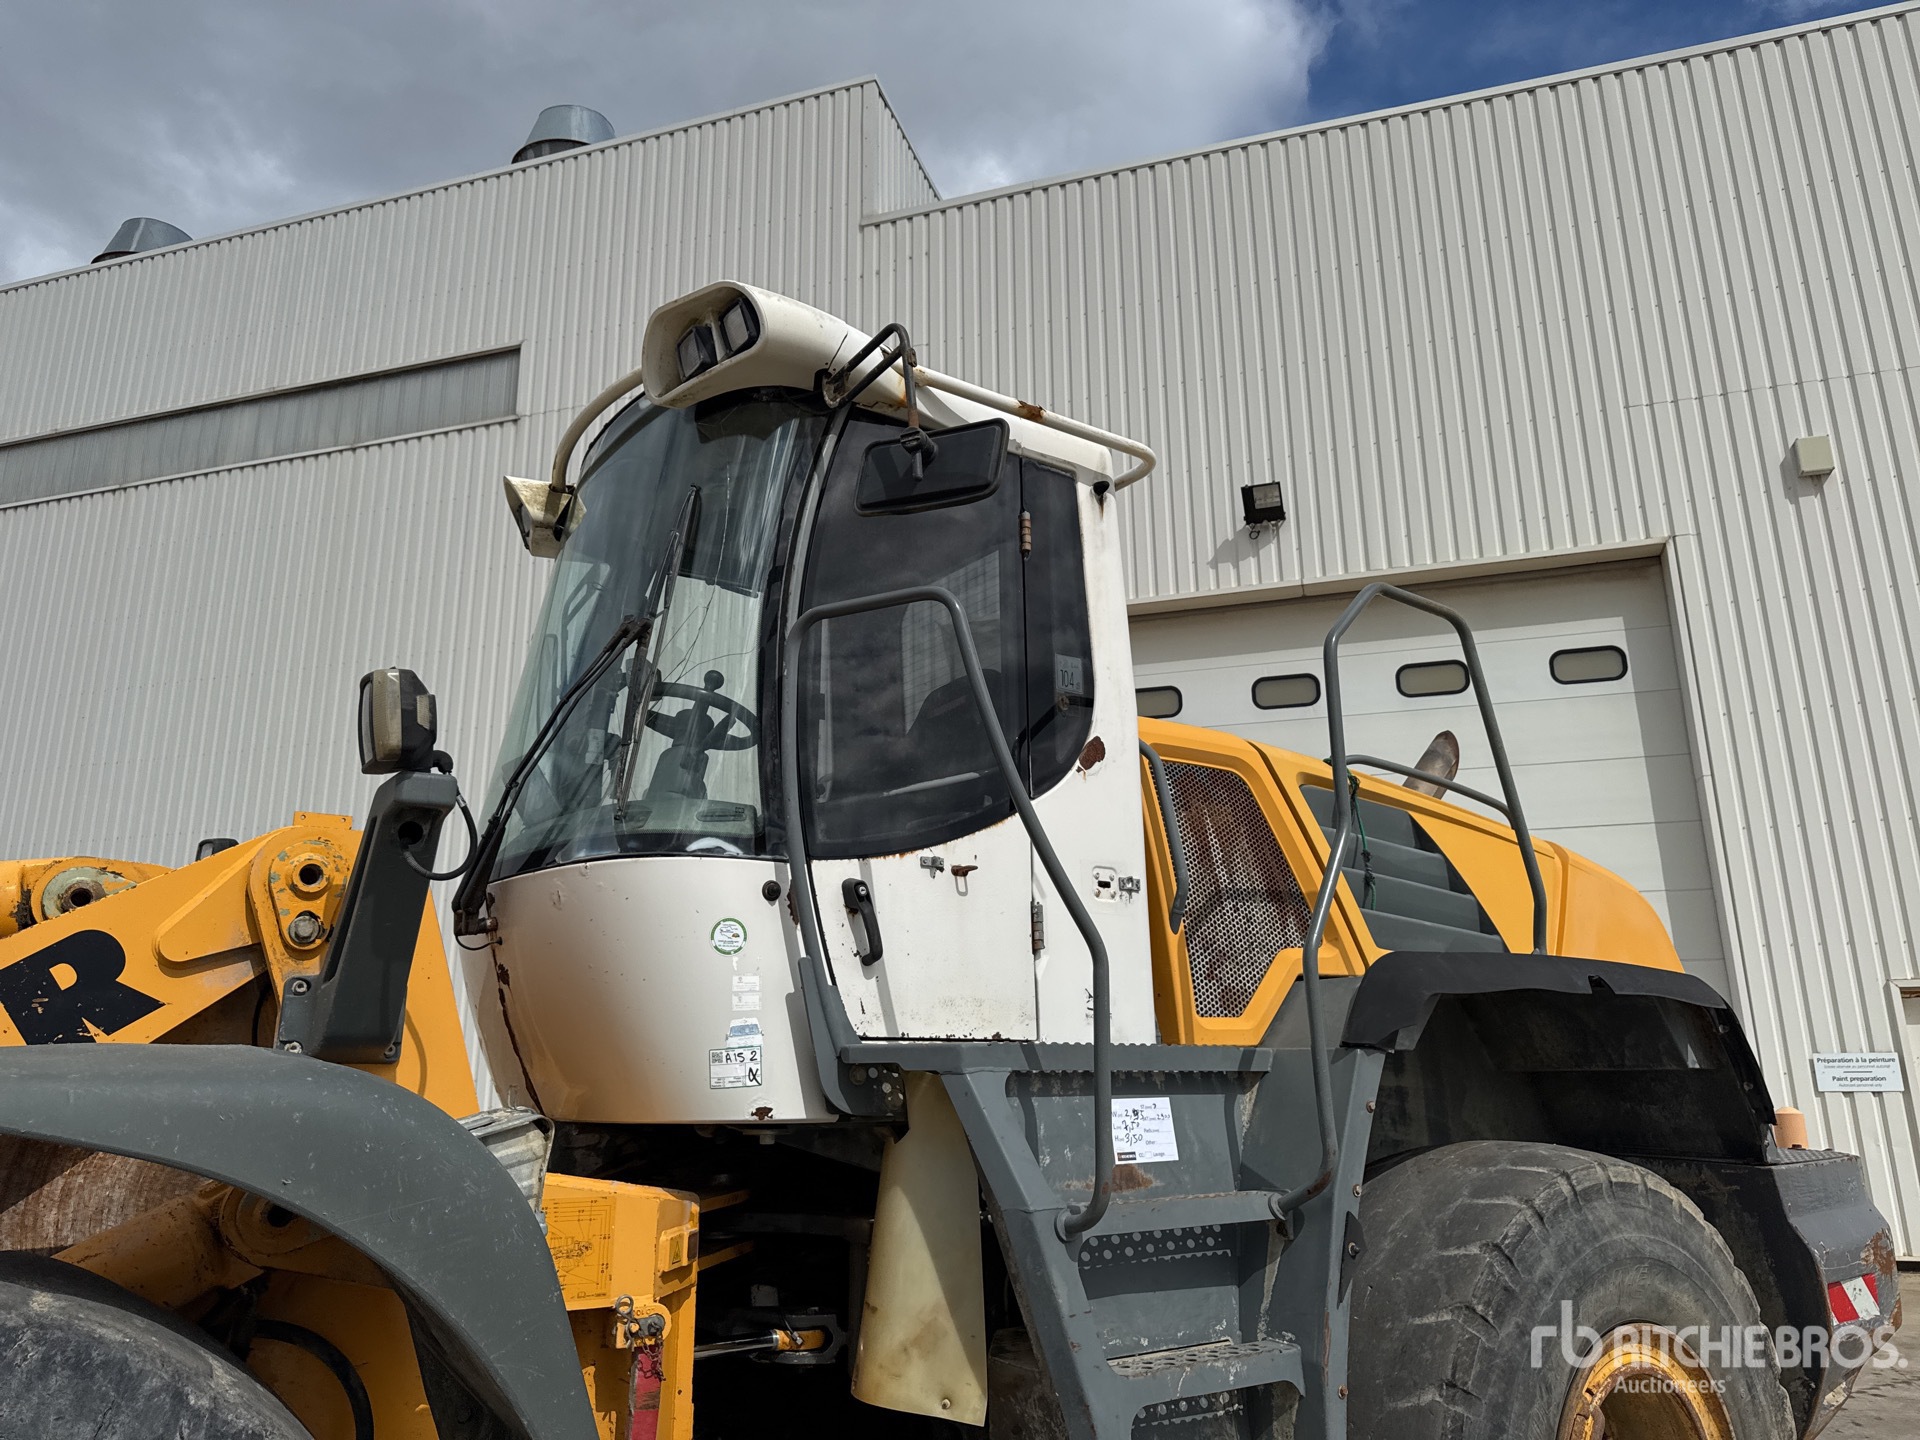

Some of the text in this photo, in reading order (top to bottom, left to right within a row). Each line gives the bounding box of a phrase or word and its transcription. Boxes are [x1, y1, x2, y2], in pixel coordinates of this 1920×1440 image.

[0, 929, 166, 1045] R
[1816, 1057, 1854, 1065] Préparation
[1868, 1056, 1896, 1064] peinture
[1849, 1075, 1887, 1083] preparation
